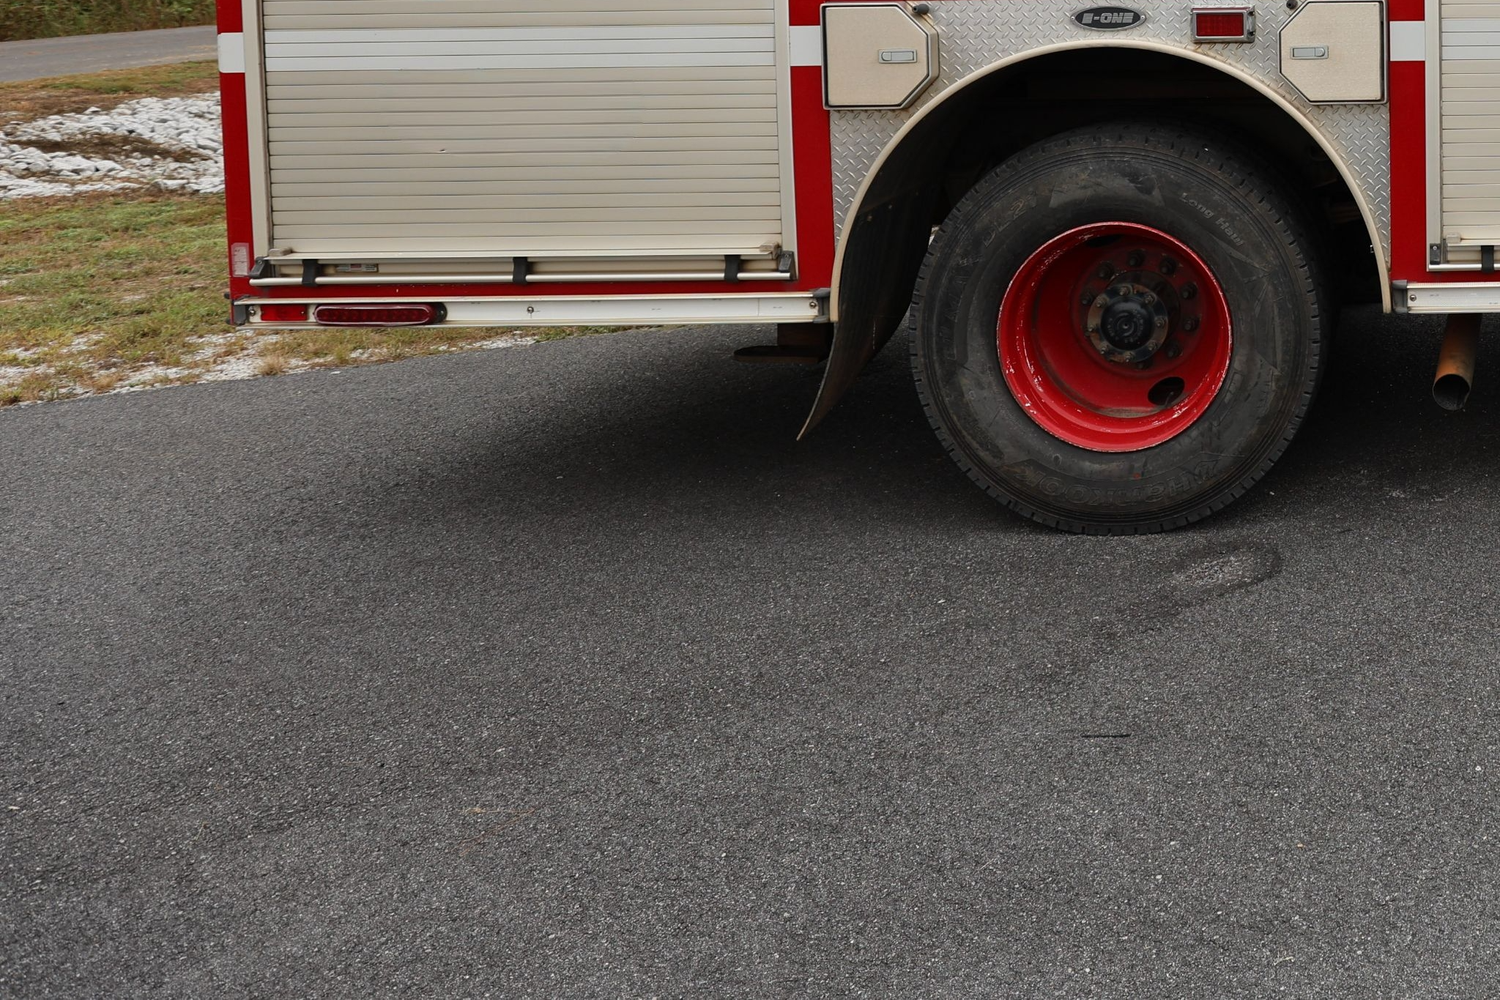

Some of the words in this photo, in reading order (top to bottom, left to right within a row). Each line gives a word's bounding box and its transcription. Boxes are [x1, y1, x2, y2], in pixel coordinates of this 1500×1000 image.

[1081, 12, 1134, 24] E-ONE
[1179, 192, 1215, 219] Long
[1215, 217, 1244, 247] Haul
